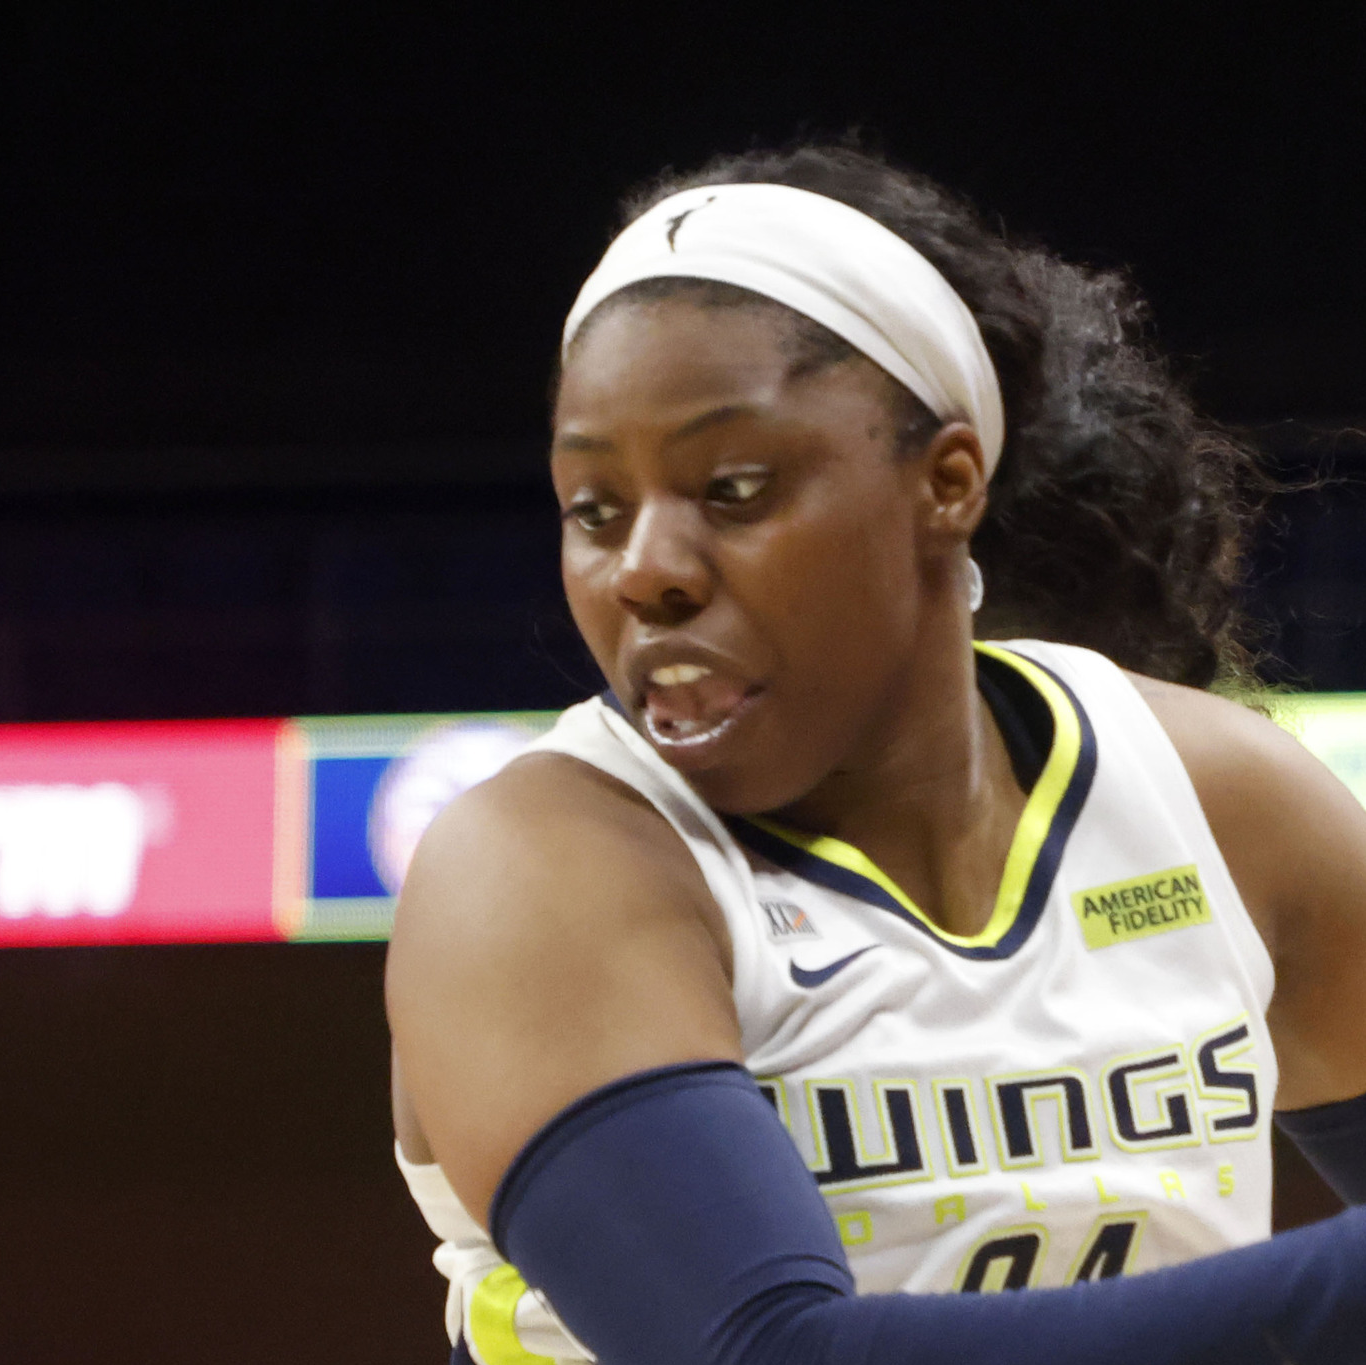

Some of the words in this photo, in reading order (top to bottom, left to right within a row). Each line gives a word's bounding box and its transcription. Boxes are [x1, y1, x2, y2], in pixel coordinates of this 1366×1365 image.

[1083, 873, 1199, 918] AMERICAN
[1108, 895, 1203, 935] FIDELITY
[838, 1164, 1235, 1247] DALLAS
